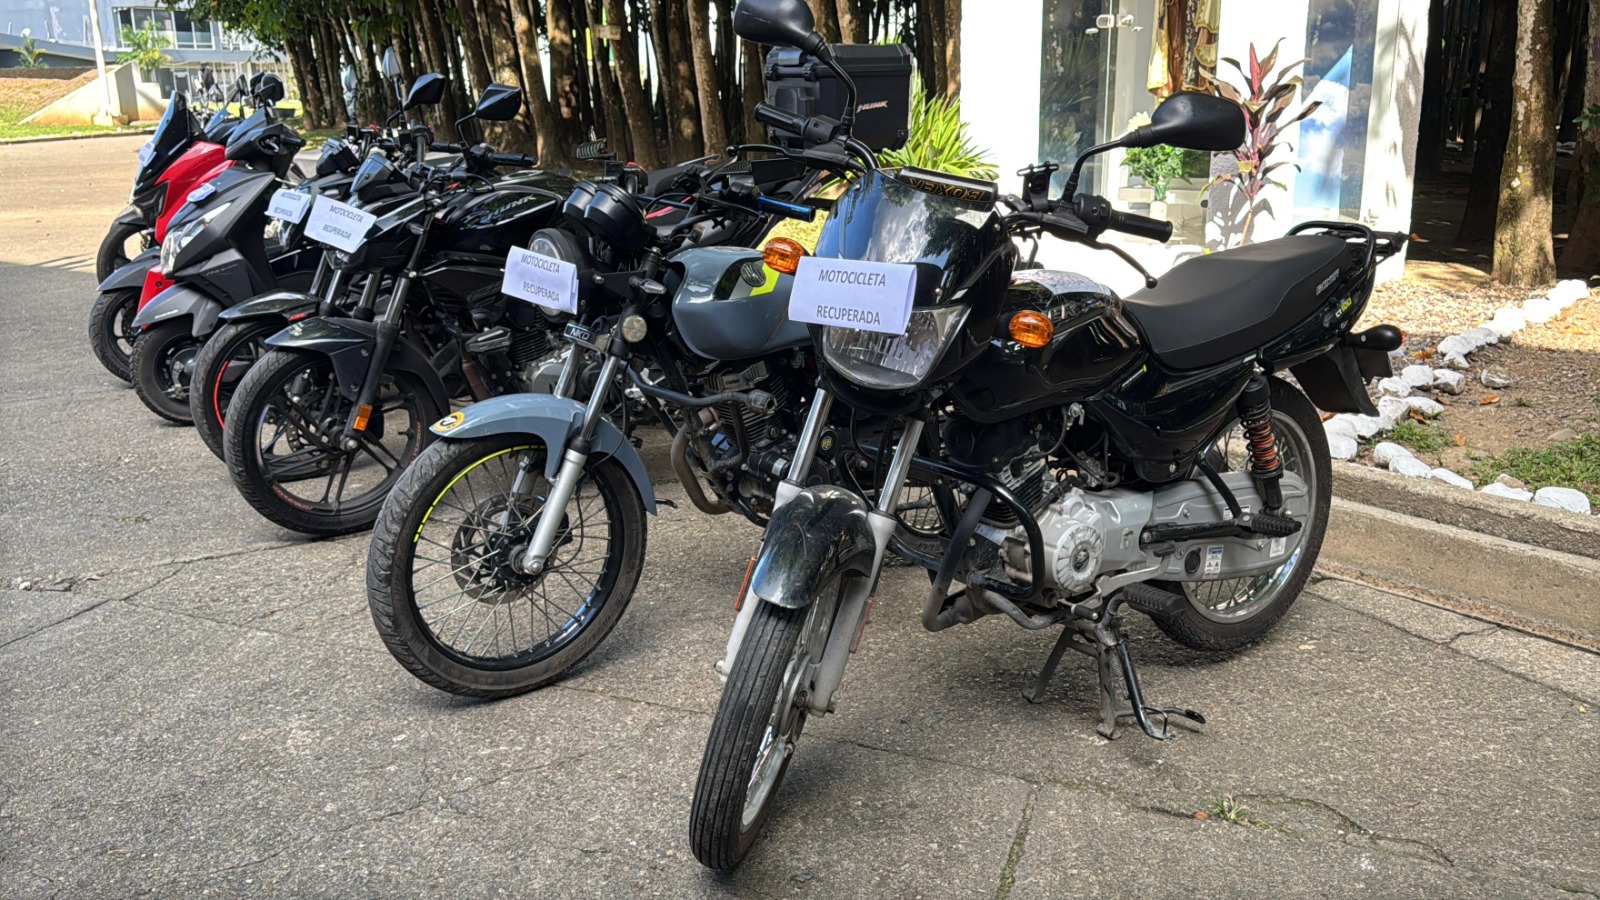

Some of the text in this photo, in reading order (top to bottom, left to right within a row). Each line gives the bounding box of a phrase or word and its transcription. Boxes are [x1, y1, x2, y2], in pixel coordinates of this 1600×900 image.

[909, 178, 985, 201] BOXER
[329, 205, 364, 223] MOTOCICLETA
[322, 224, 352, 240] RECUPERADA
[520, 253, 560, 275] MOTOCICLETA
[818, 269, 887, 287] MOTOCICLETA
[522, 281, 560, 303] RECUPERADA
[816, 304, 881, 326] RECUPERADA
